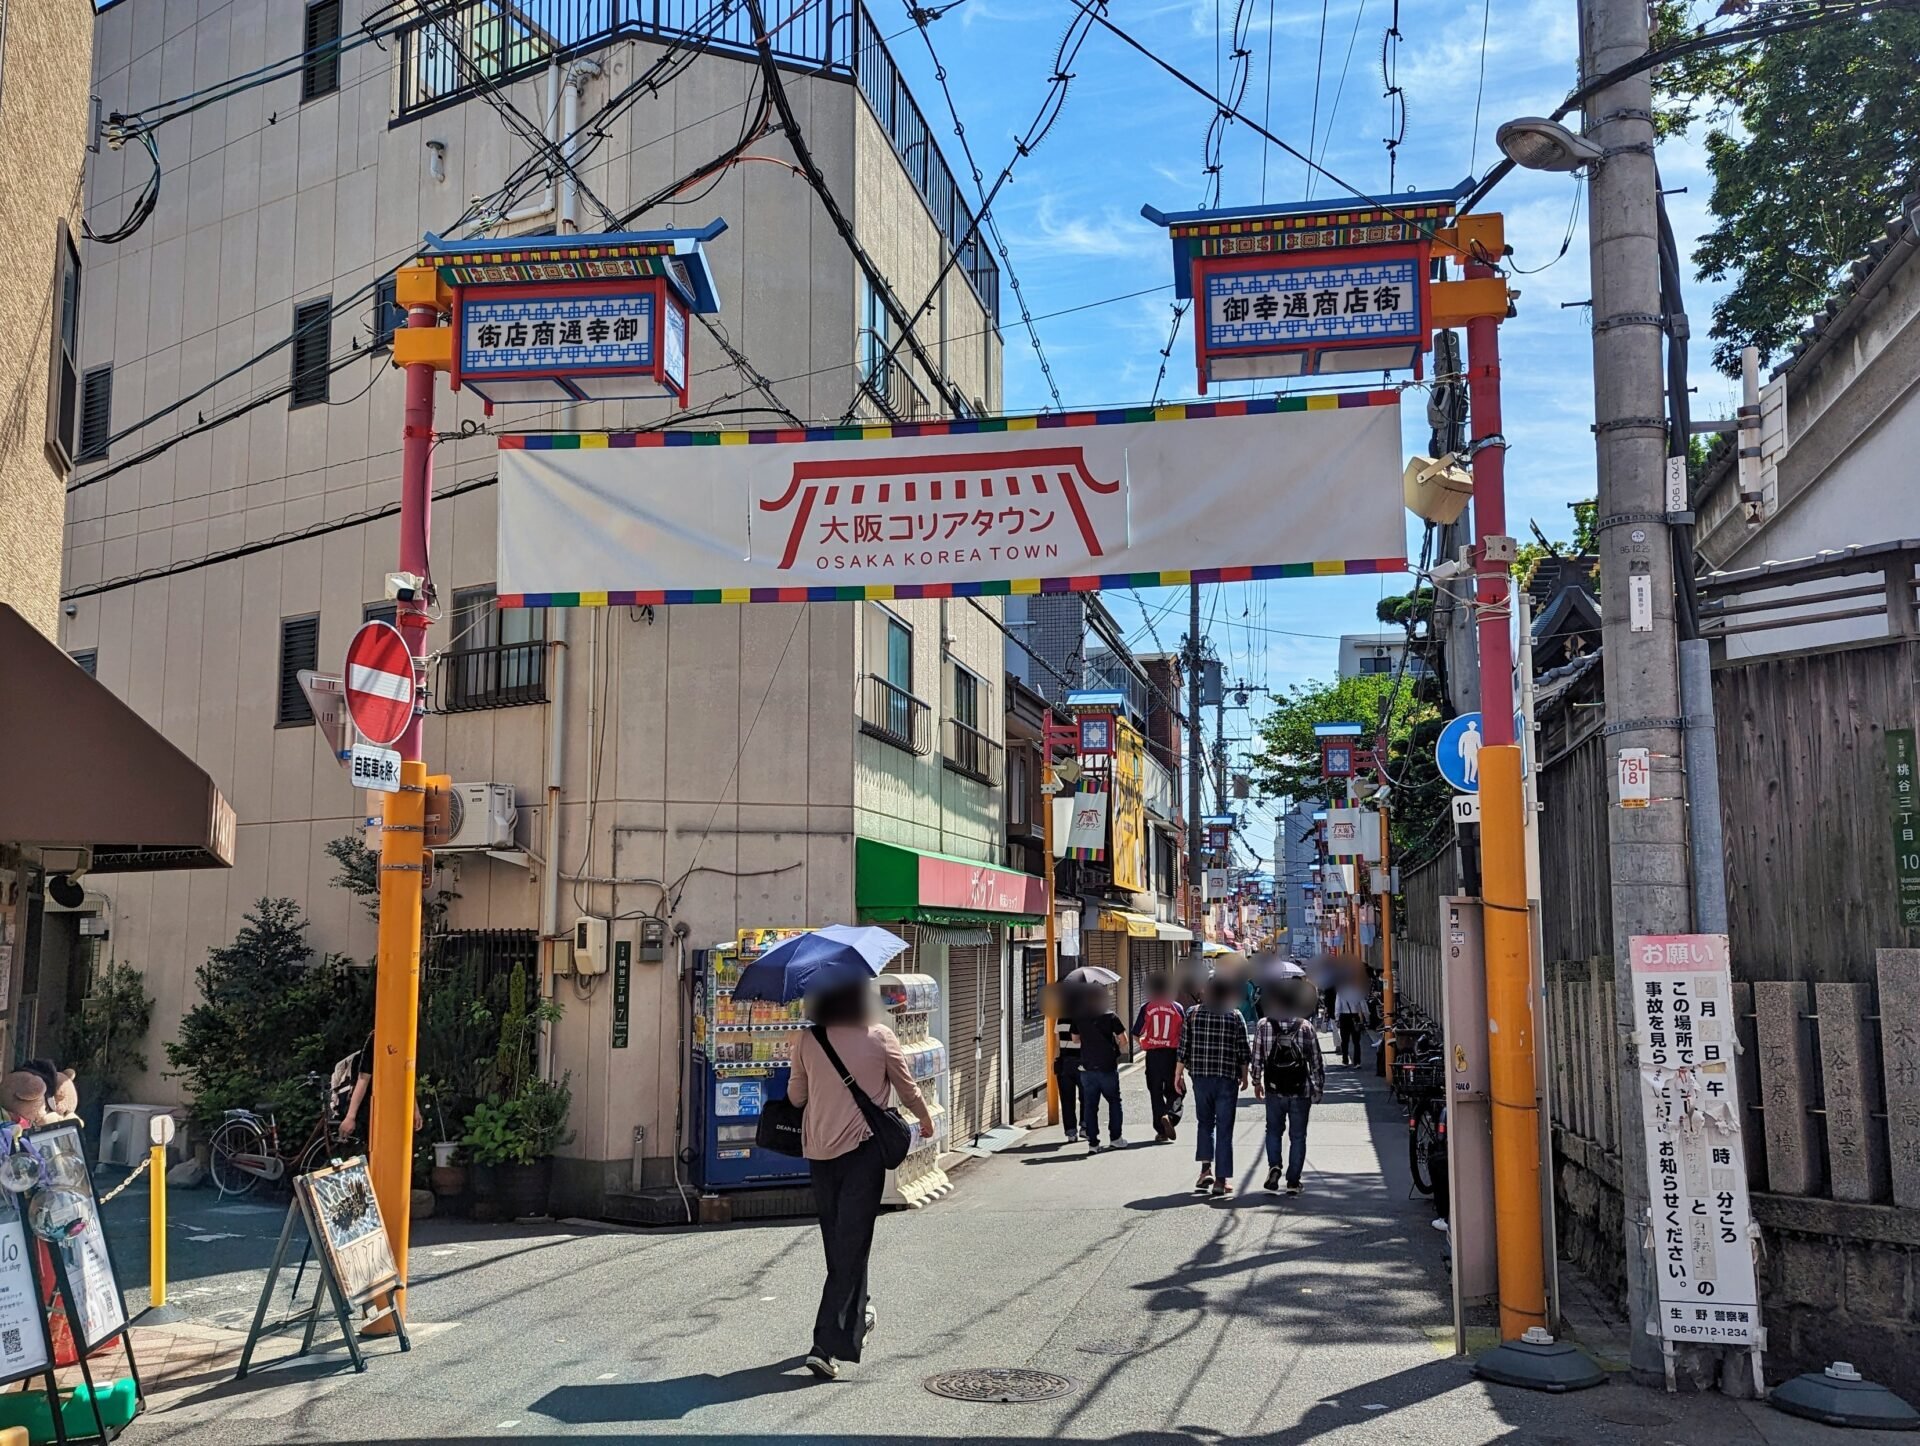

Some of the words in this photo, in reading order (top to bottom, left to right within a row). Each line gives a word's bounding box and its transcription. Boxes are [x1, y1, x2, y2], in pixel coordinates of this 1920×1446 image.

[1222, 286, 1401, 322] 御幸通商店街
[819, 506, 1055, 544] 大阪コリアタウン
[816, 553, 895, 570] OSAKA
[904, 548, 981, 566] KOREA
[989, 544, 1058, 561] TOWN
[355, 755, 399, 782] 自転車を除く
[1620, 759, 1648, 772] 75L
[1622, 772, 1645, 784] 181
[1897, 763, 1914, 841] 桃谷三丁目
[1901, 854, 1920, 870] 10
[1641, 943, 1714, 965] お願い
[1700, 1001, 1717, 1018] 月
[1153, 1014, 1171, 1039] 11
[1672, 981, 1694, 1064] この場所で
[1704, 1045, 1720, 1061] 日
[1706, 1081, 1724, 1097] 午
[1712, 1148, 1731, 1165] 時
[1659, 1141, 1687, 1288] お知らせください。
[1691, 1200, 1707, 1215] と
[1717, 1192, 1737, 1243] 分ころ
[1697, 1281, 1715, 1296] の
[1673, 1325, 1748, 1338] 06-6712-1234
